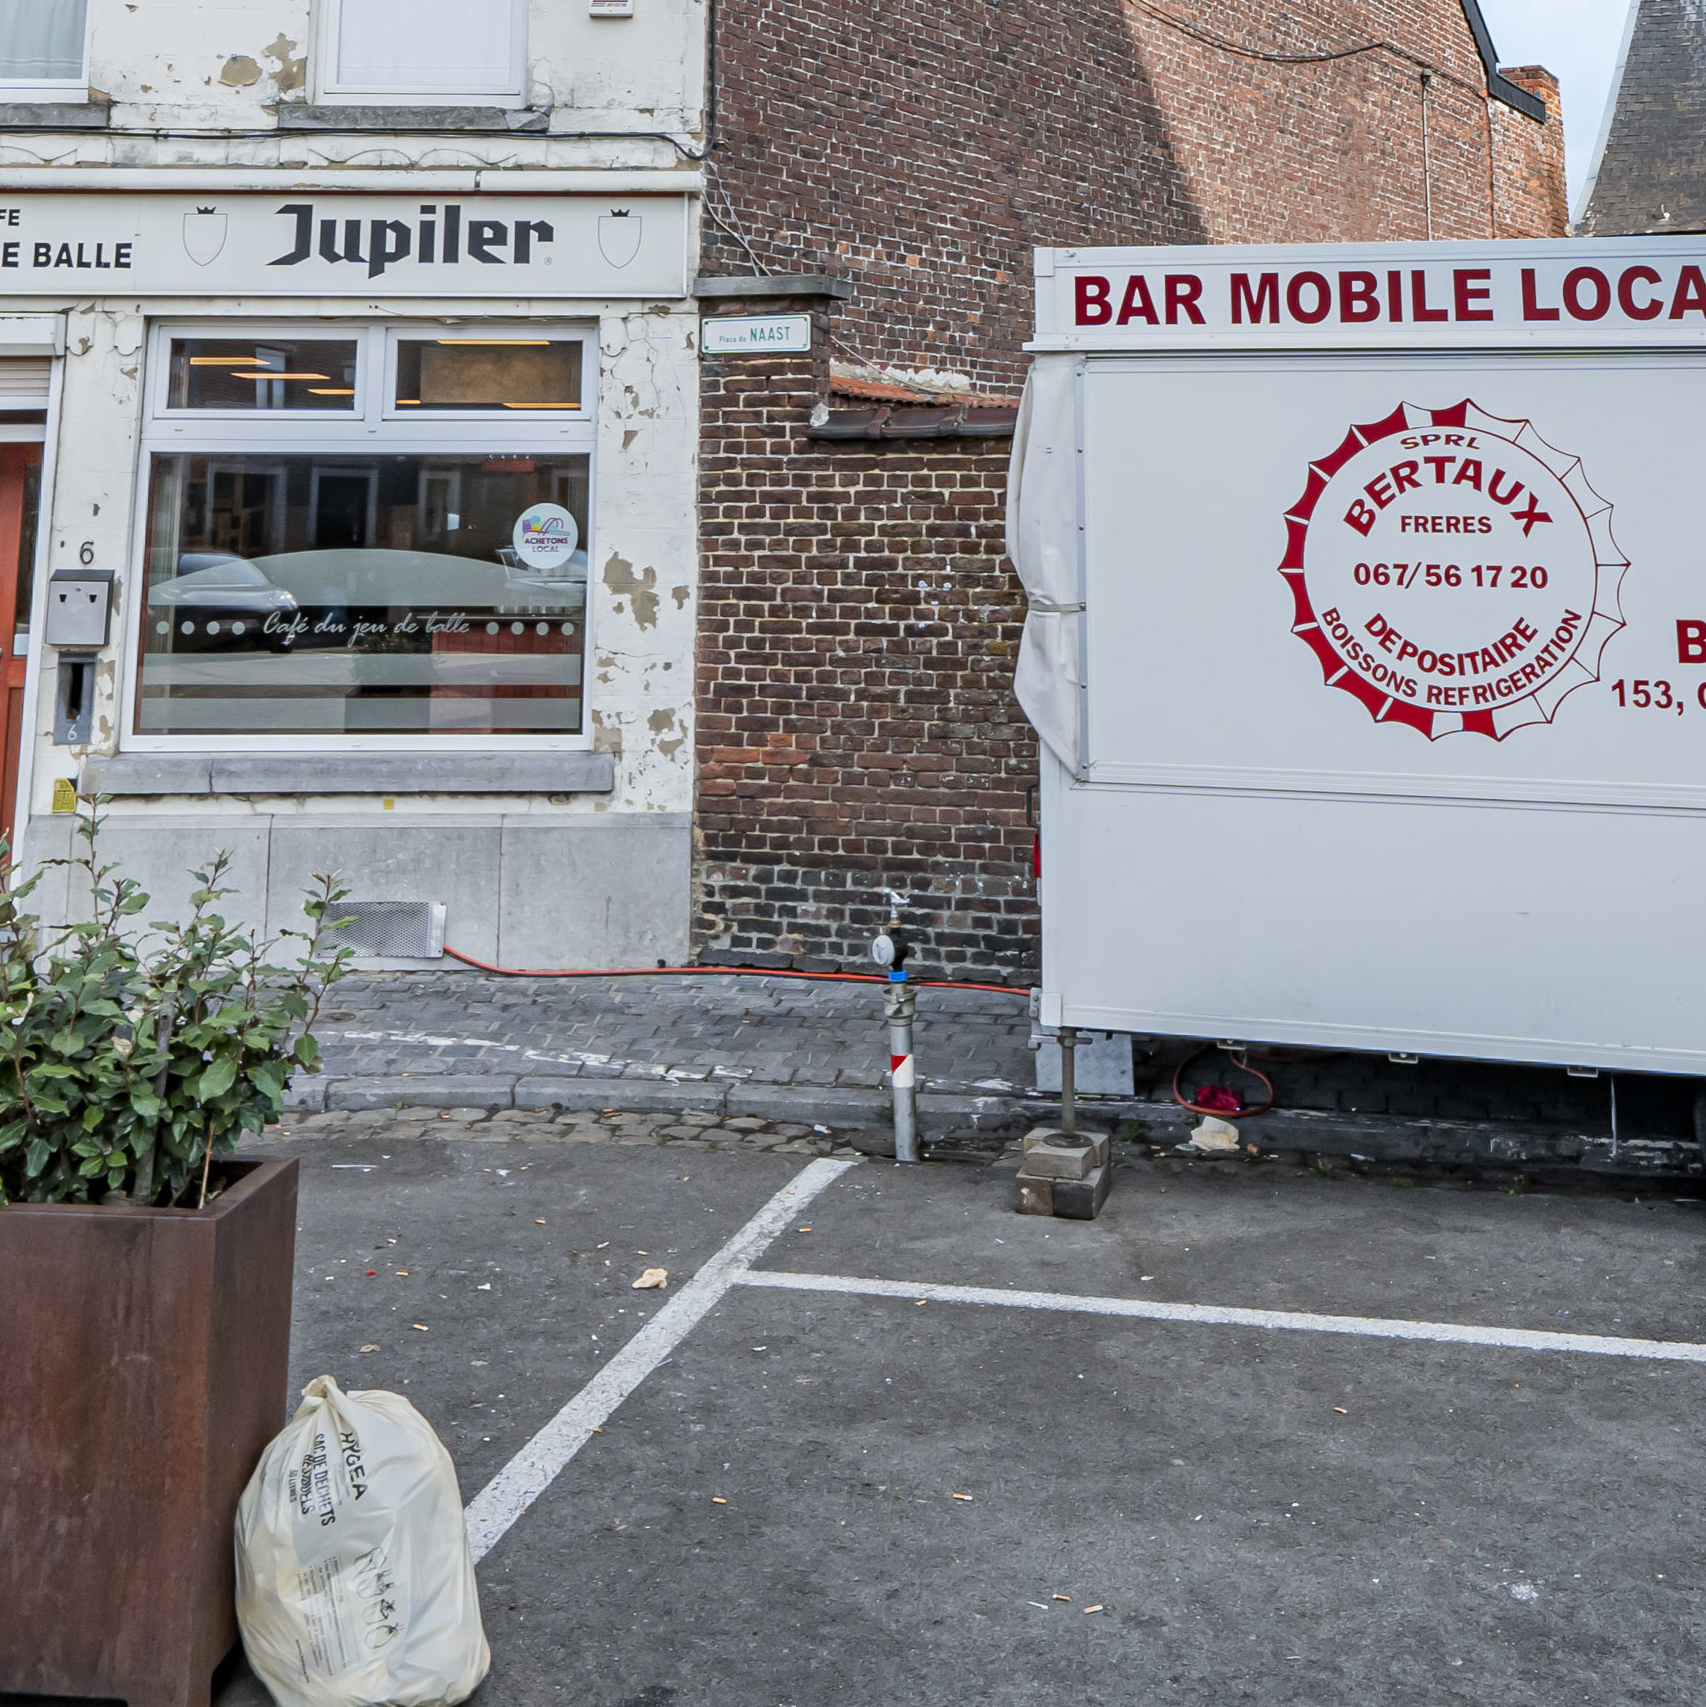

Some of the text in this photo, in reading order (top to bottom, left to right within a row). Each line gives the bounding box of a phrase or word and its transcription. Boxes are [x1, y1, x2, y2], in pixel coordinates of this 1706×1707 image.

[265, 203, 555, 280] Jupiler
[33, 242, 133, 269] BALLE
[1074, 274, 1206, 327] BAR
[1231, 268, 1494, 325] MOBILE
[719, 335, 737, 343] Place
[750, 326, 791, 341] NAAST
[1400, 433, 1481, 450] SPRL
[1343, 455, 1554, 538] BERTAUX
[1400, 515, 1493, 534] FRERES
[79, 540, 95, 565] 6
[524, 537, 568, 545] ACHETONS
[532, 545, 559, 553] LOCAL
[1353, 562, 1463, 589] 067/56
[262, 610, 470, 648] Café du jeu de balle
[1321, 607, 1583, 706] BOISSONS REFRIGERATION
[1363, 612, 1539, 677] DEPOSITAIRE
[1611, 678, 1684, 716] 153,
[67, 724, 78, 741] 6
[313, 1454, 328, 1470] DE
[340, 1431, 369, 1502] HYGEA
